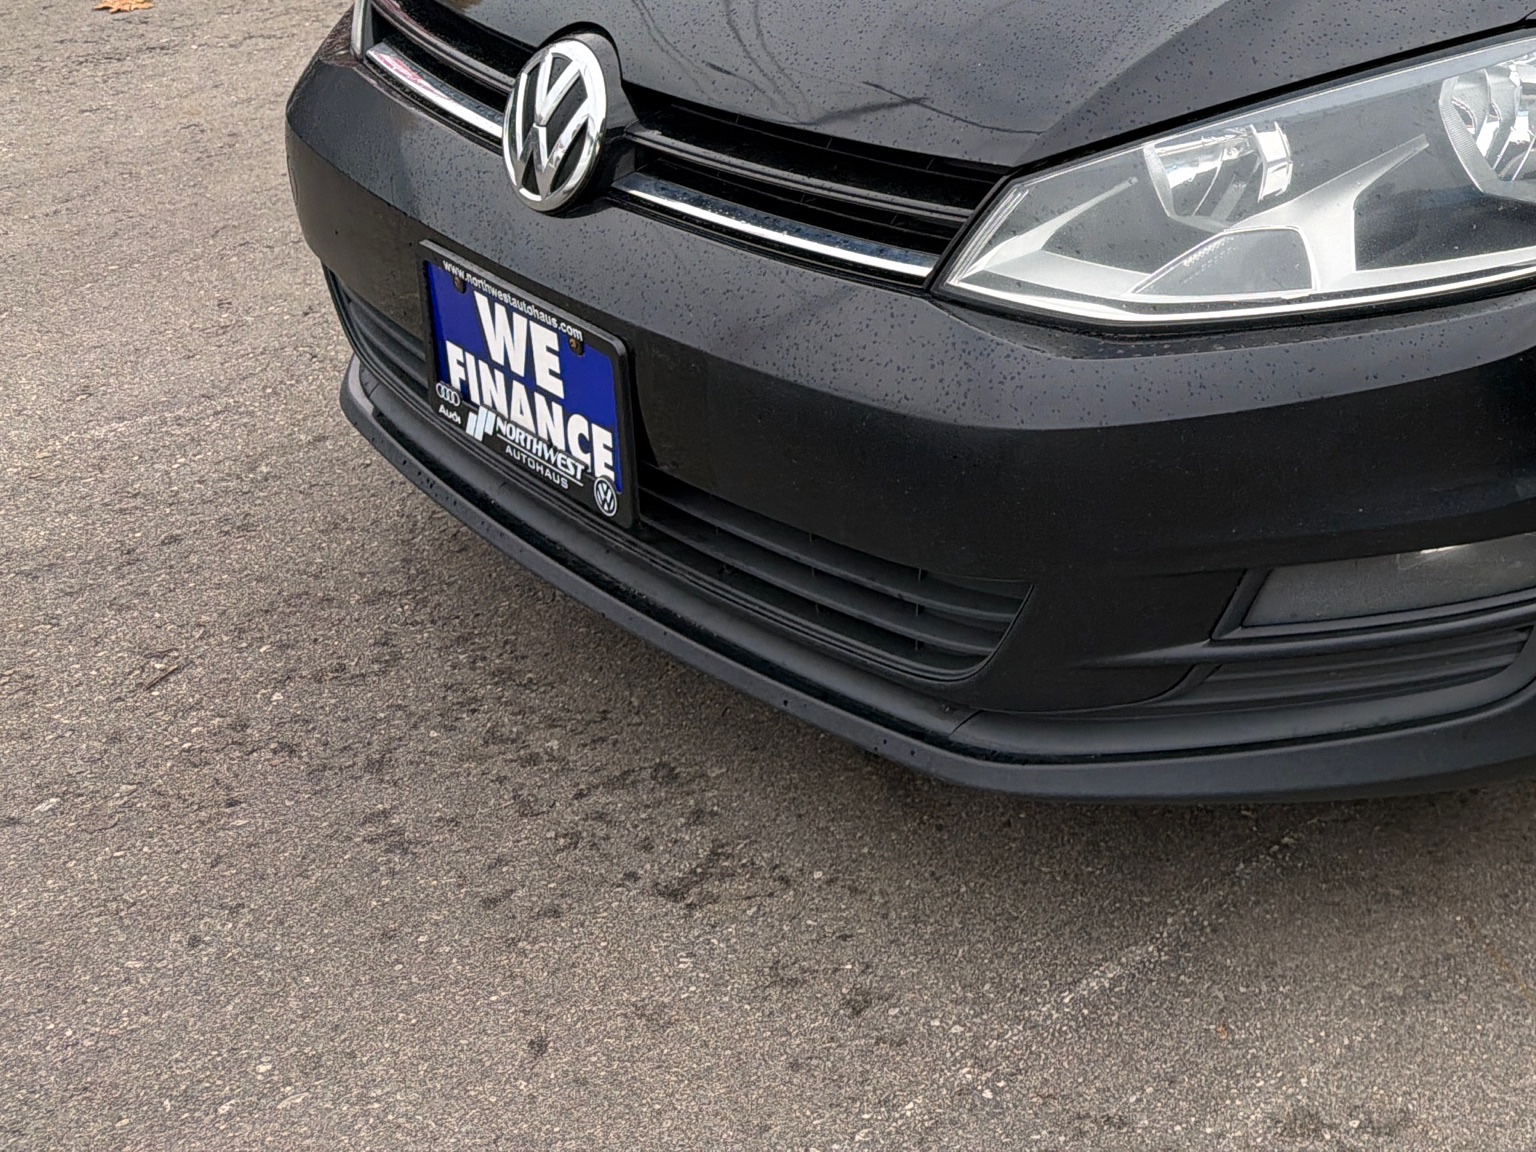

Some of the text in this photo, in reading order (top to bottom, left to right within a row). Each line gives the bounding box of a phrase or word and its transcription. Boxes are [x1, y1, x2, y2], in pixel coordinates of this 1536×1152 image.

[502, 38, 607, 213] VW
[442, 259, 584, 342] www.northwestautohaus.com
[474, 291, 565, 400] WE
[446, 340, 616, 483] FINANCE
[495, 416, 586, 481] NORTHWEST
[505, 444, 569, 490] AUTOHAUS
